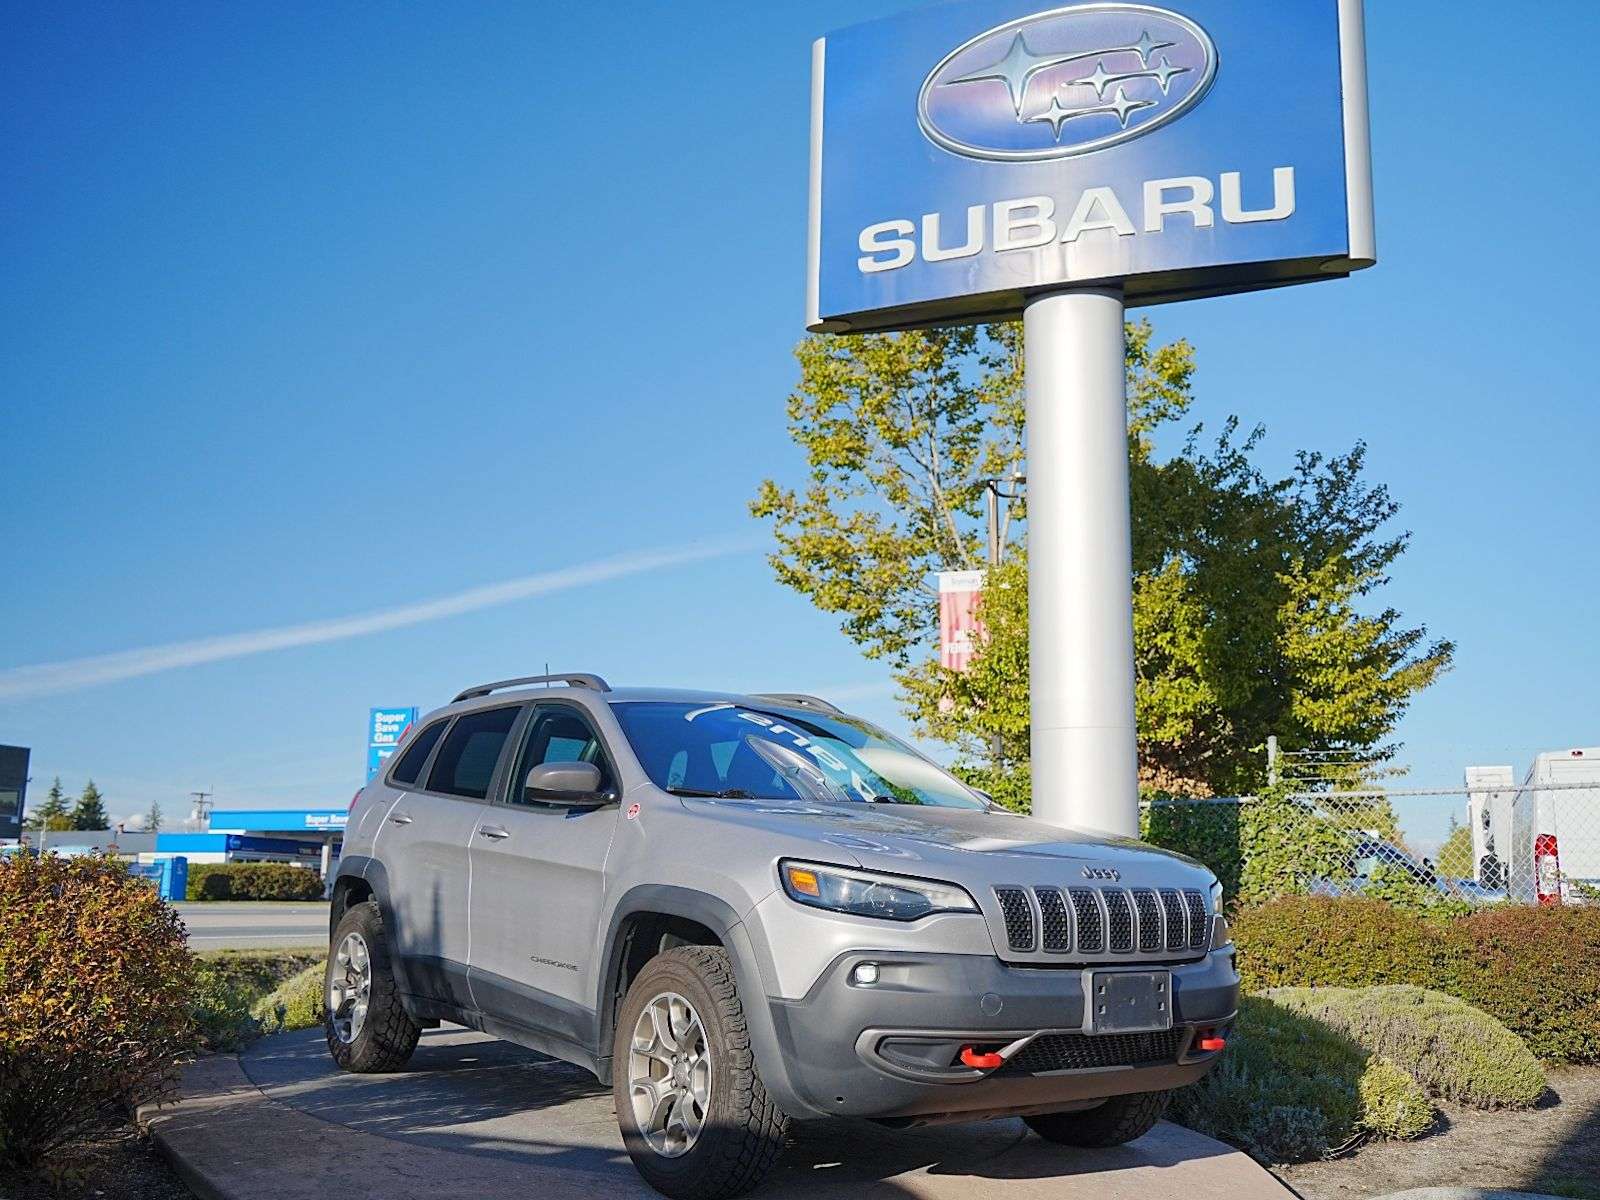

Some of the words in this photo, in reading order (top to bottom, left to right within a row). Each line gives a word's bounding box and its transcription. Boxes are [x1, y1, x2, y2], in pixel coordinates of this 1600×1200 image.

[857, 166, 1296, 274] SUBARU
[375, 712, 406, 724] Super
[375, 723, 400, 733] Save
[374, 733, 394, 742] Gas
[1081, 865, 1120, 882] Jeep
